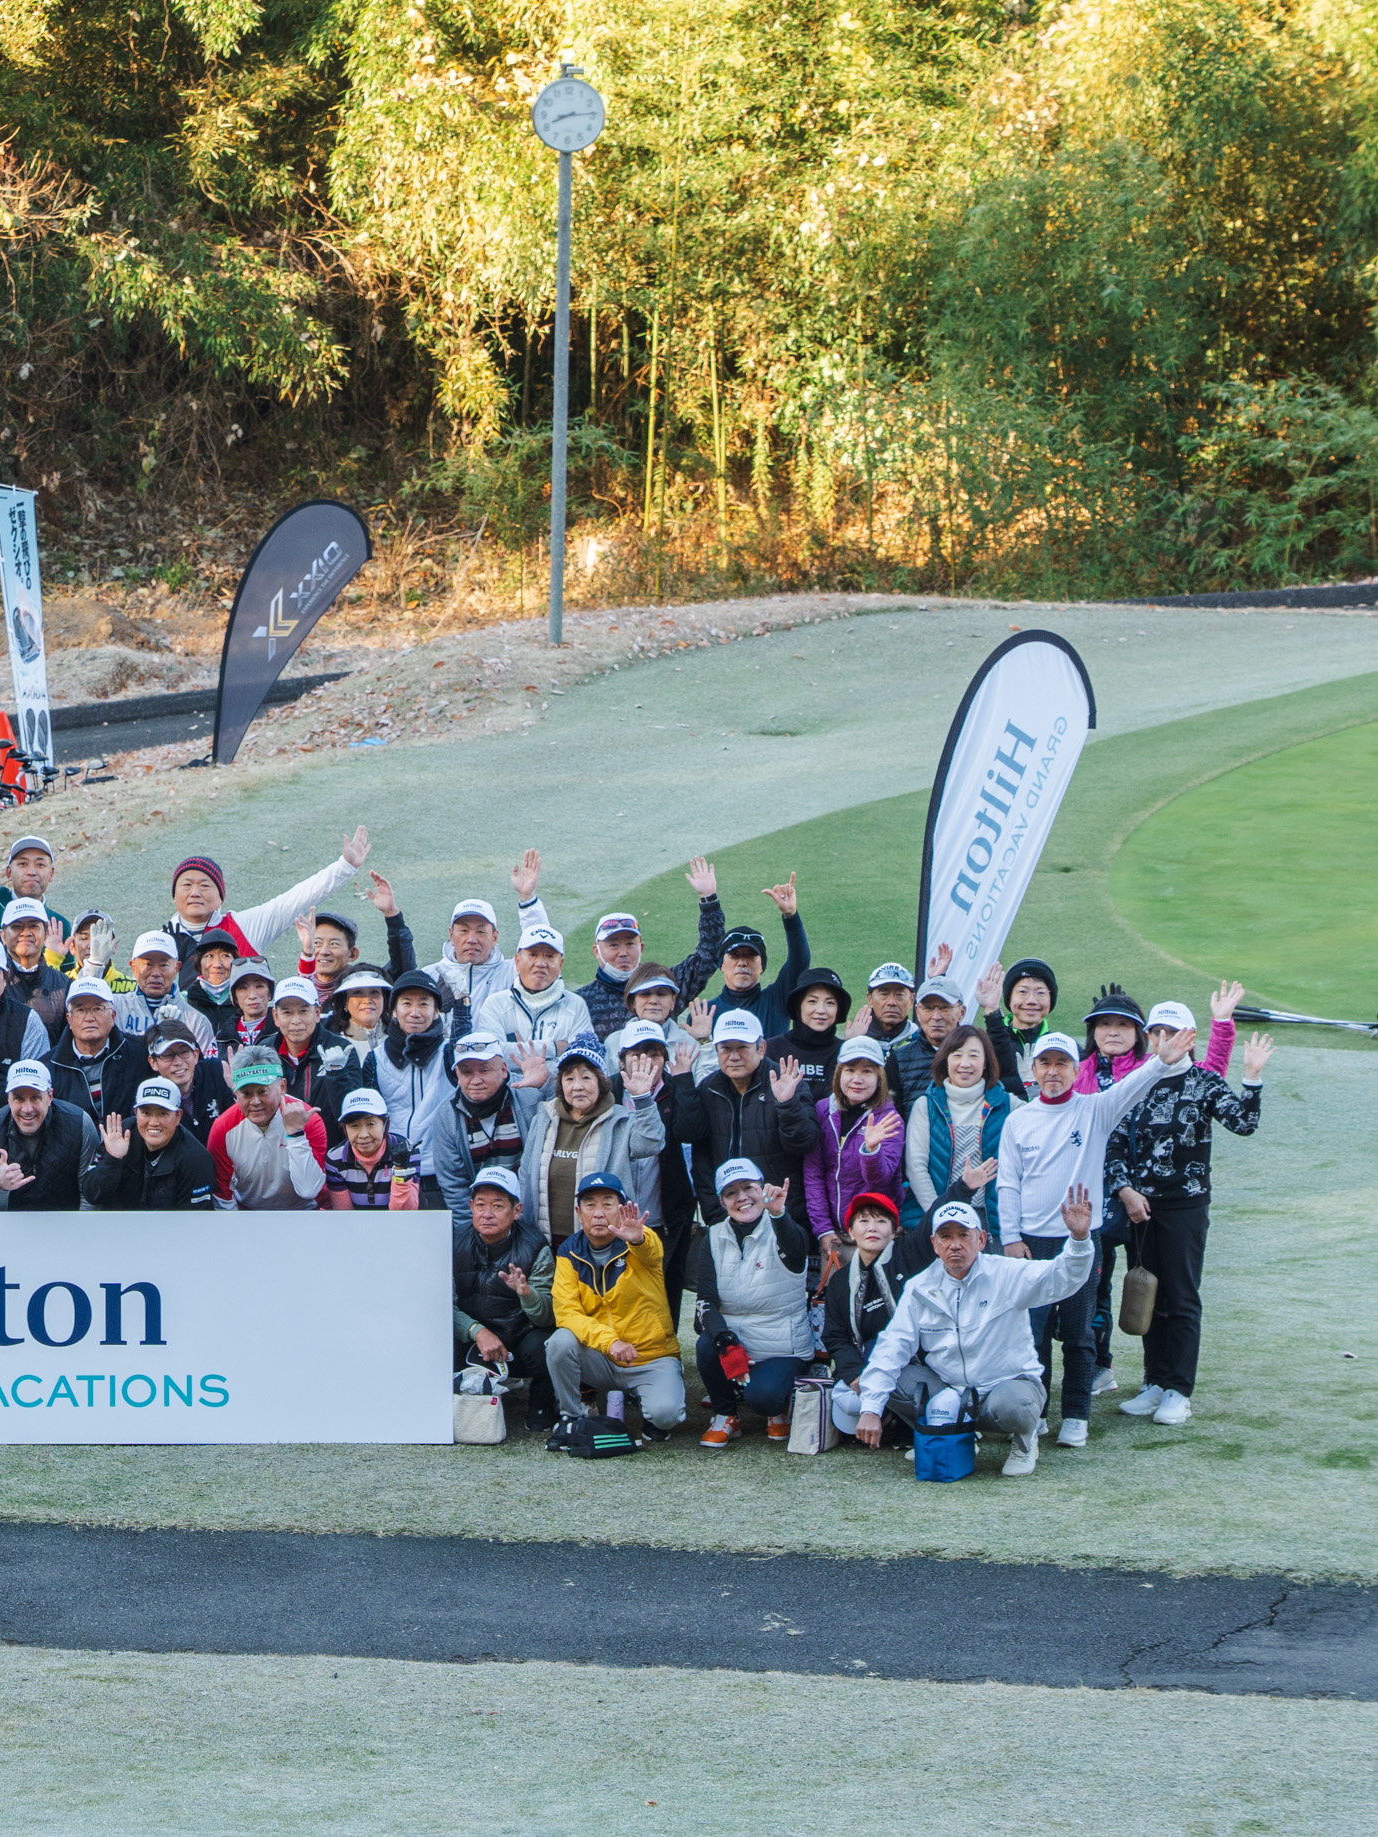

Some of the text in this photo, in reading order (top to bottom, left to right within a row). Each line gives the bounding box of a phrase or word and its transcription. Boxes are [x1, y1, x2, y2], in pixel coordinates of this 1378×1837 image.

[530, 928, 557, 940] Callaway
[724, 1019, 746, 1028] Hilton
[15, 1067, 38, 1075] Hilton
[143, 1087, 170, 1099] PING
[350, 1096, 370, 1104] Hilton
[938, 1206, 968, 1218] Callaway
